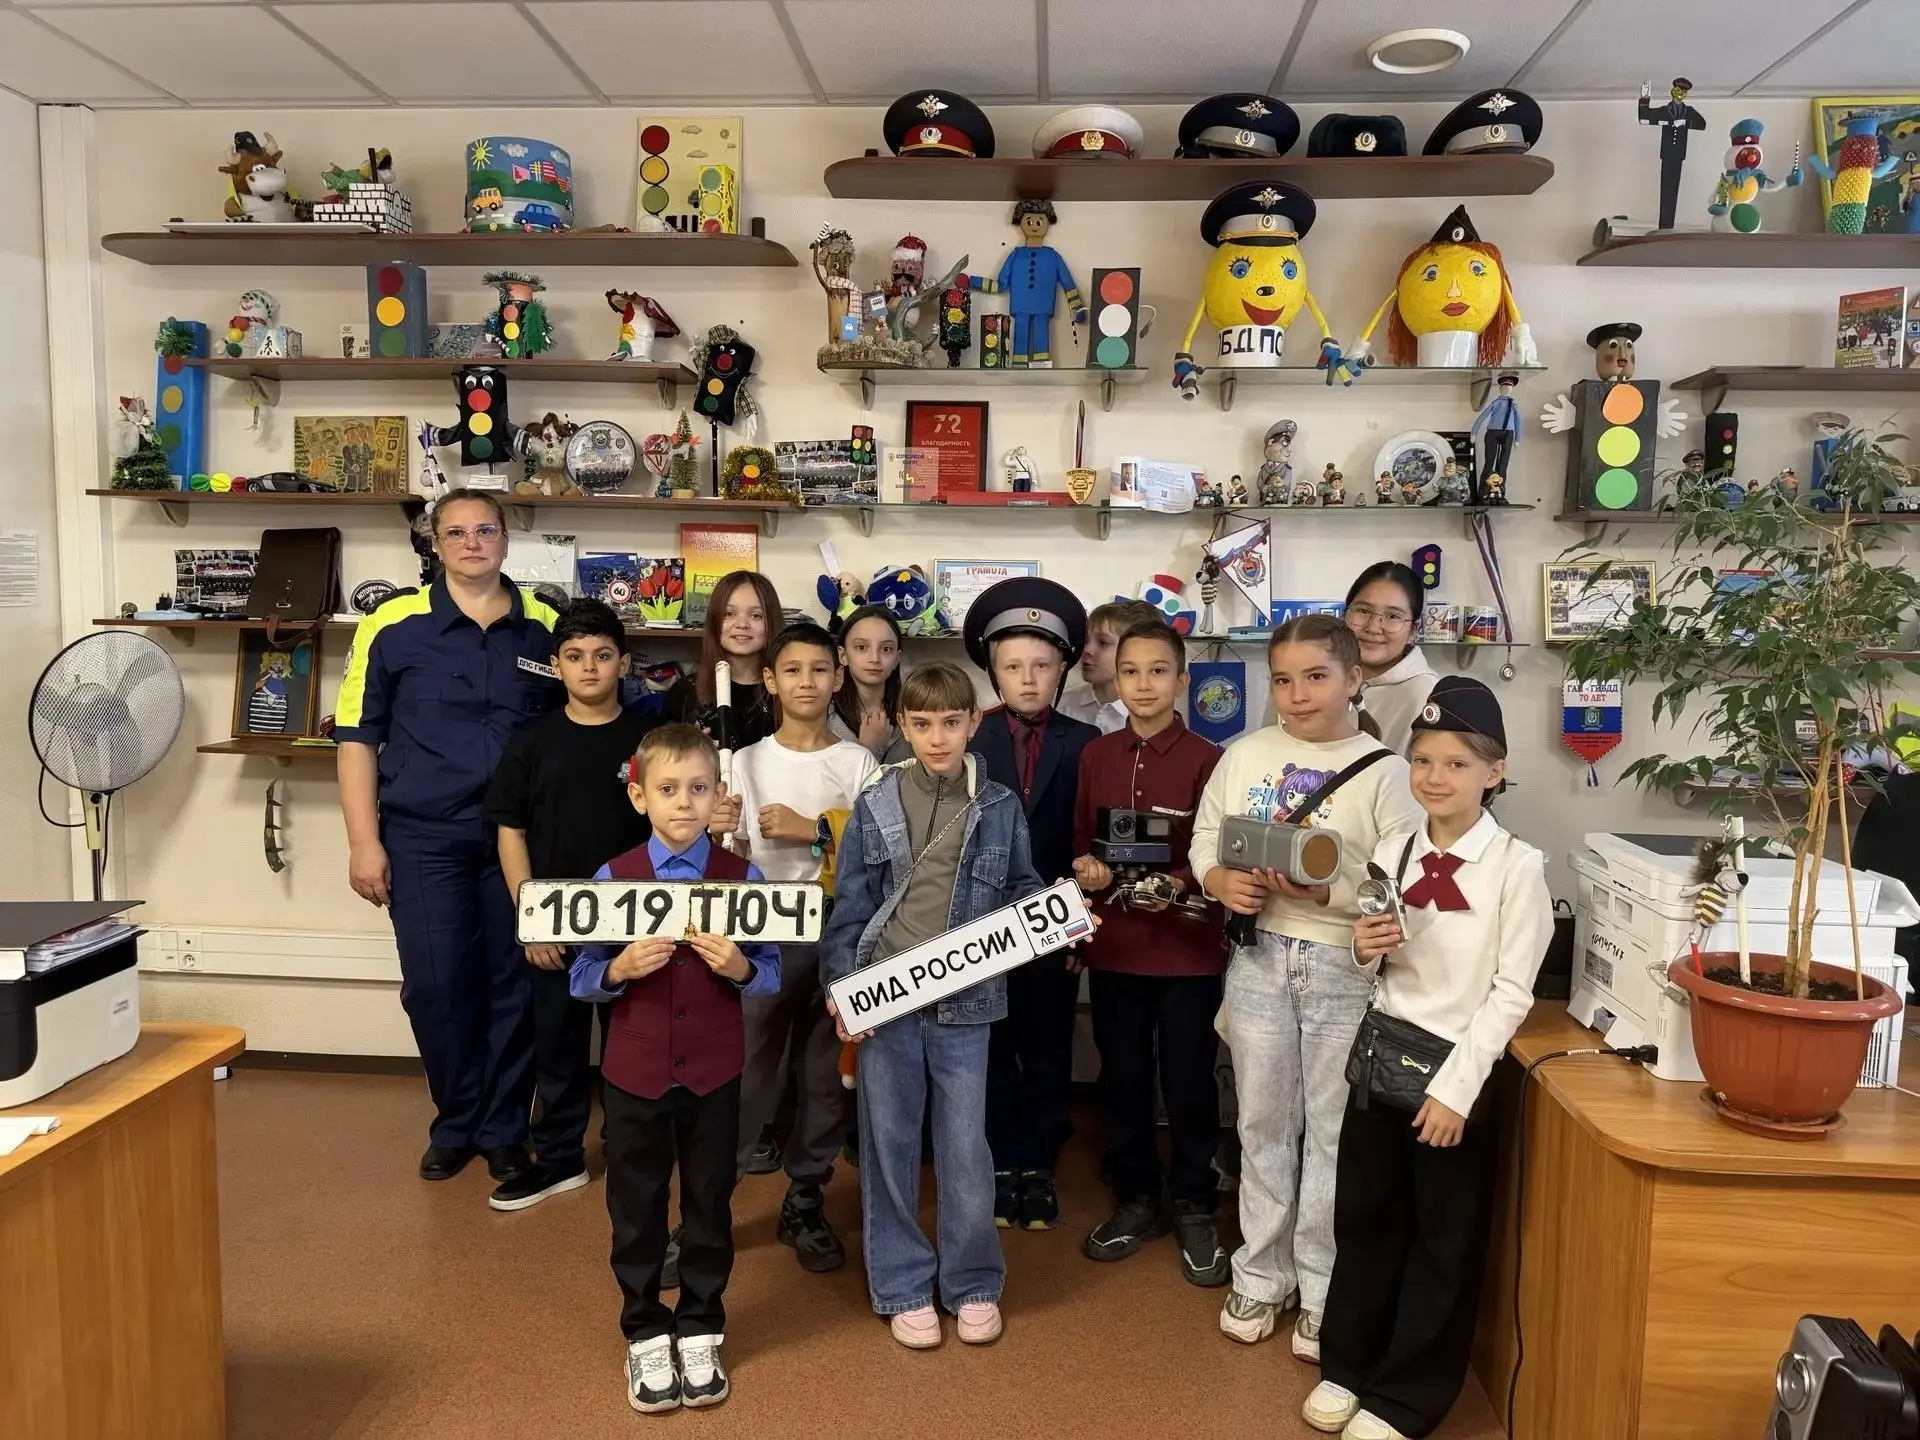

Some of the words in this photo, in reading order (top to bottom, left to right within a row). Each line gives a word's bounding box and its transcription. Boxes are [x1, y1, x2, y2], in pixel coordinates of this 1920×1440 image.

[614, 588, 627, 597] 60
[519, 659, 533, 669] ДПС
[1580, 694, 1589, 702] 70
[1590, 694, 1607, 702] ЛЕТ
[540, 889, 599, 936] 10
[614, 889, 674, 936] 19
[691, 887, 807, 937] ТЮЧ
[1023, 893, 1070, 934] 50
[1040, 931, 1061, 948] ЛЕТ
[848, 975, 909, 1016] ЮИД
[908, 926, 1017, 990] РОССИИ
